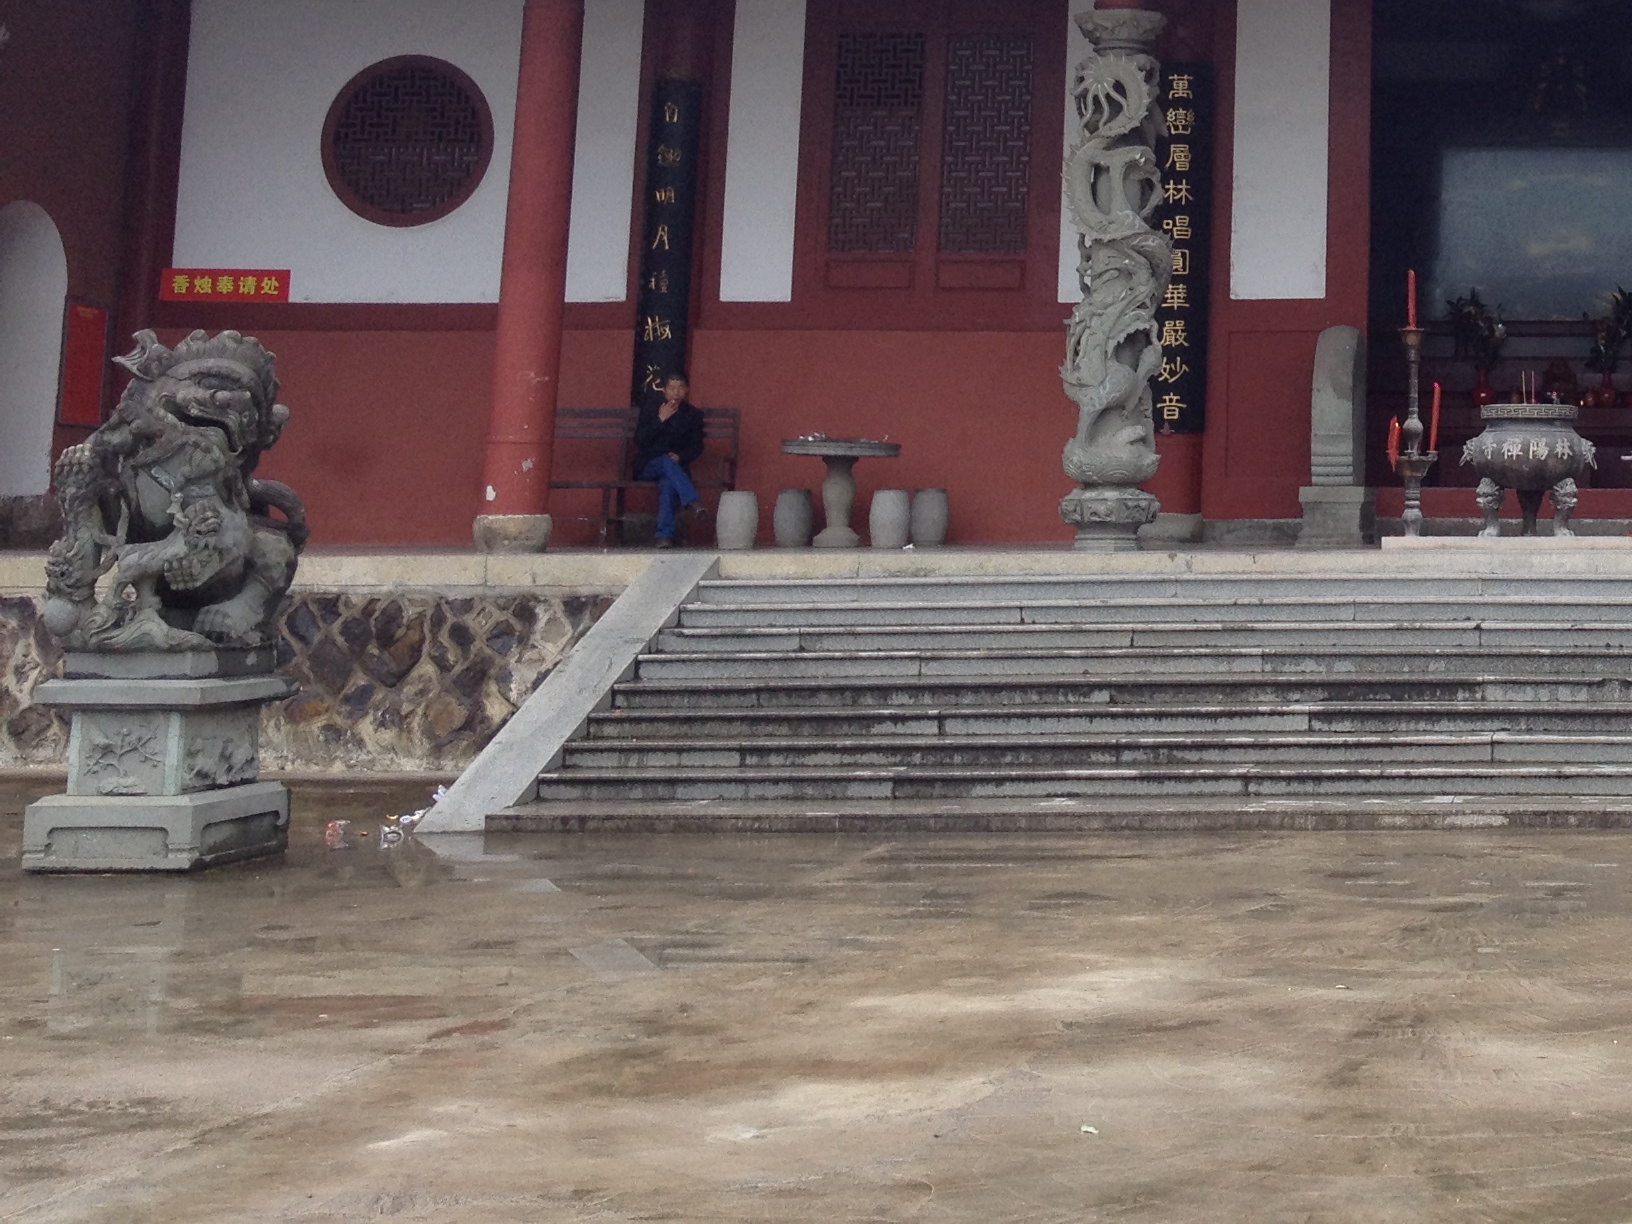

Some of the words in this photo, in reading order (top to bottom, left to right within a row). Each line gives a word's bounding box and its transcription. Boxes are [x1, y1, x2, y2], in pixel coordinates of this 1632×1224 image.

[171, 274, 280, 296] 香烛奉请处
